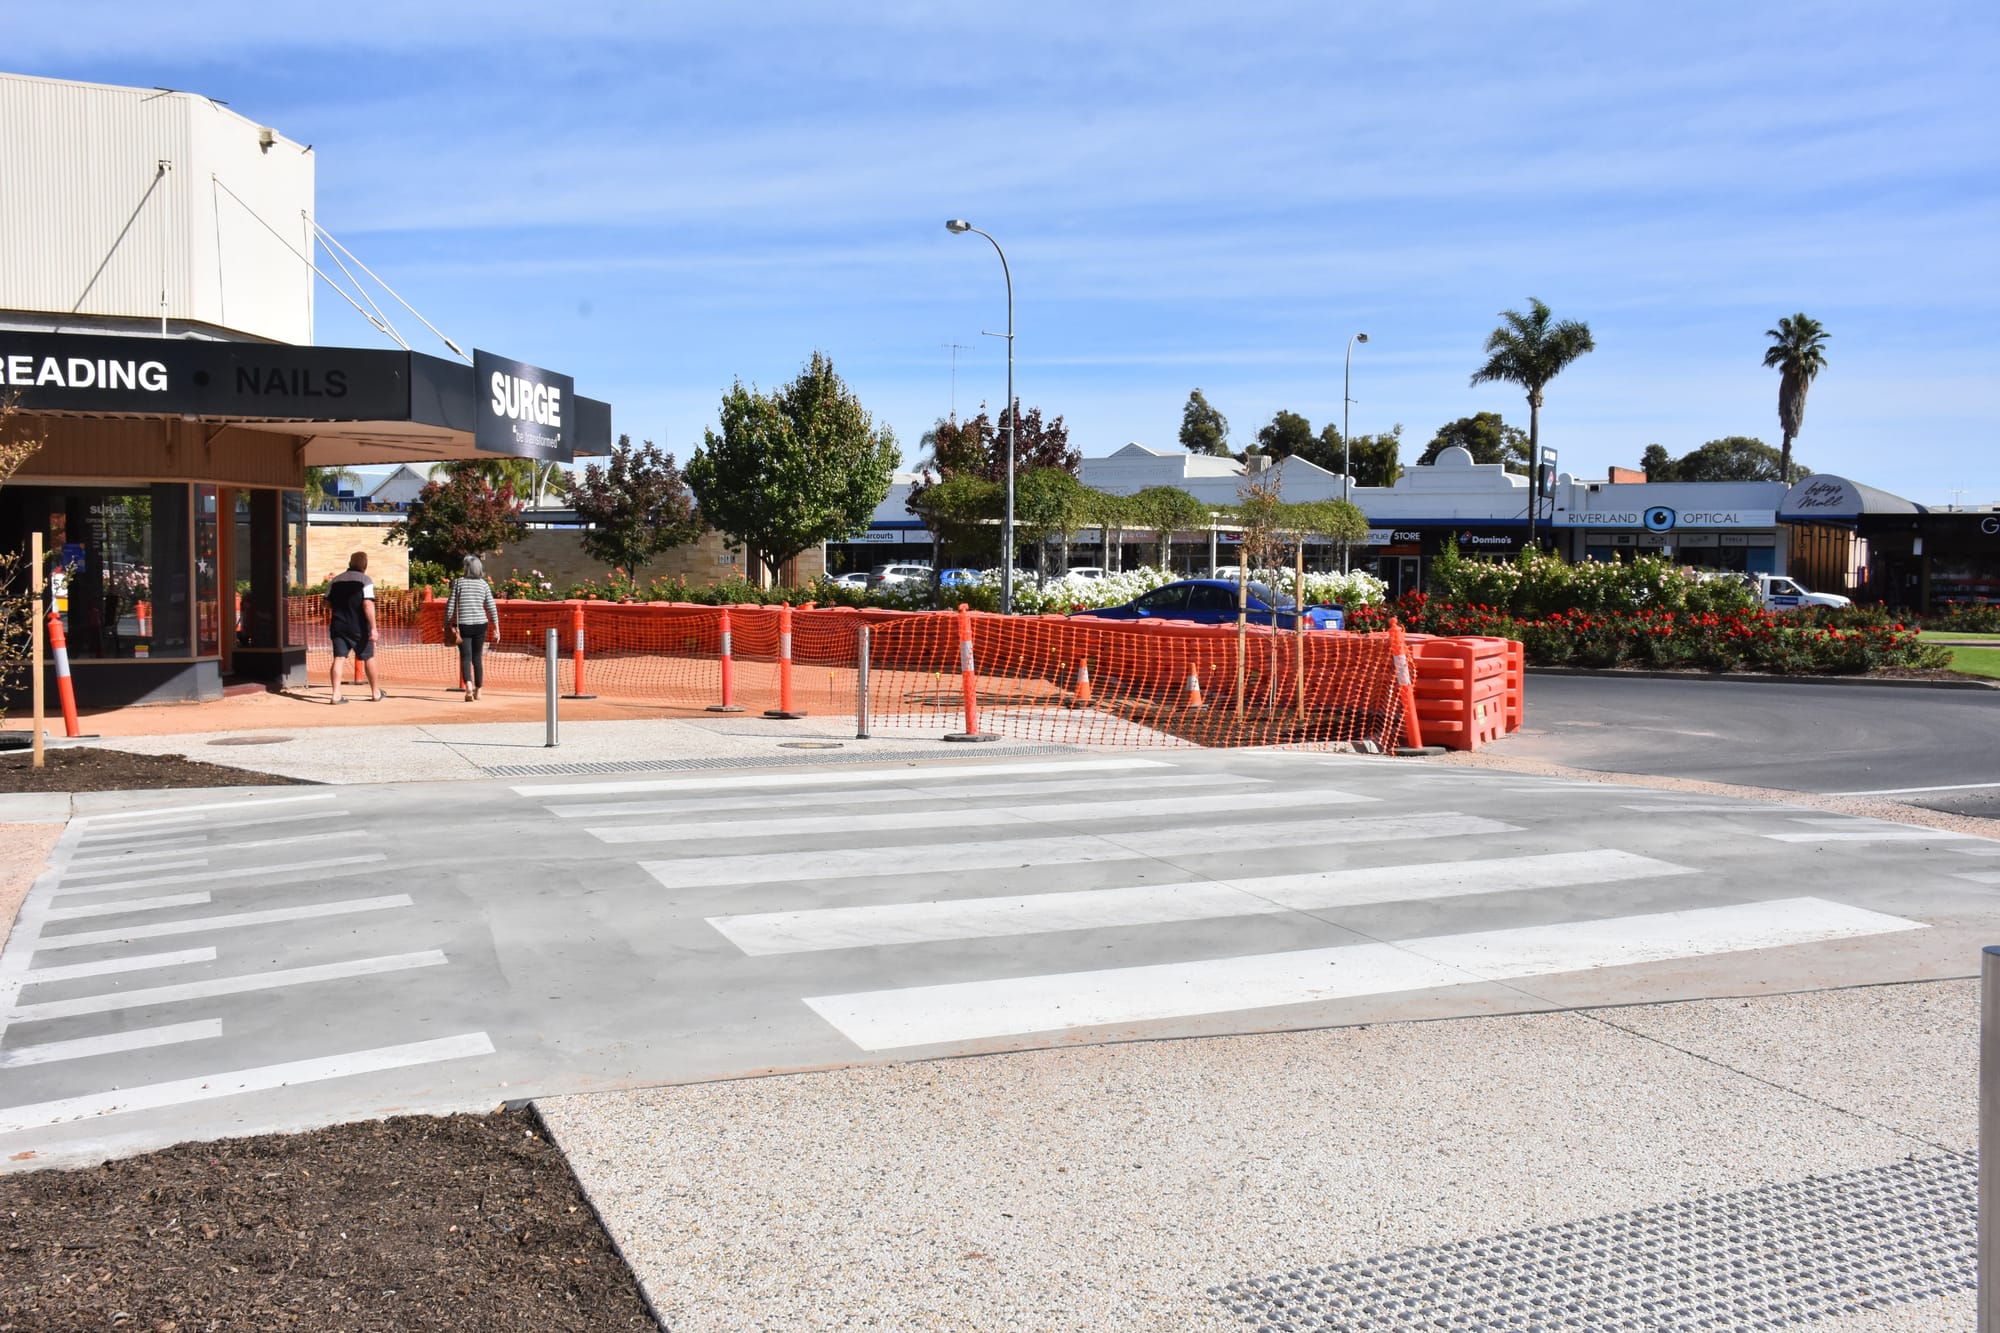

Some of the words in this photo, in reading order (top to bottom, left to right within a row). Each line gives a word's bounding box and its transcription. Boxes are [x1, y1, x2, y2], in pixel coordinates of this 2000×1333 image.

[0, 355, 168, 391] EADING
[236, 366, 348, 398] NAILS
[491, 371, 561, 427] SURGE
[1568, 513, 1637, 524] RIVERLAND
[1683, 513, 1740, 524] OPTICAL
[1394, 532, 1421, 540] STORE
[1472, 535, 1512, 544] Domino's
